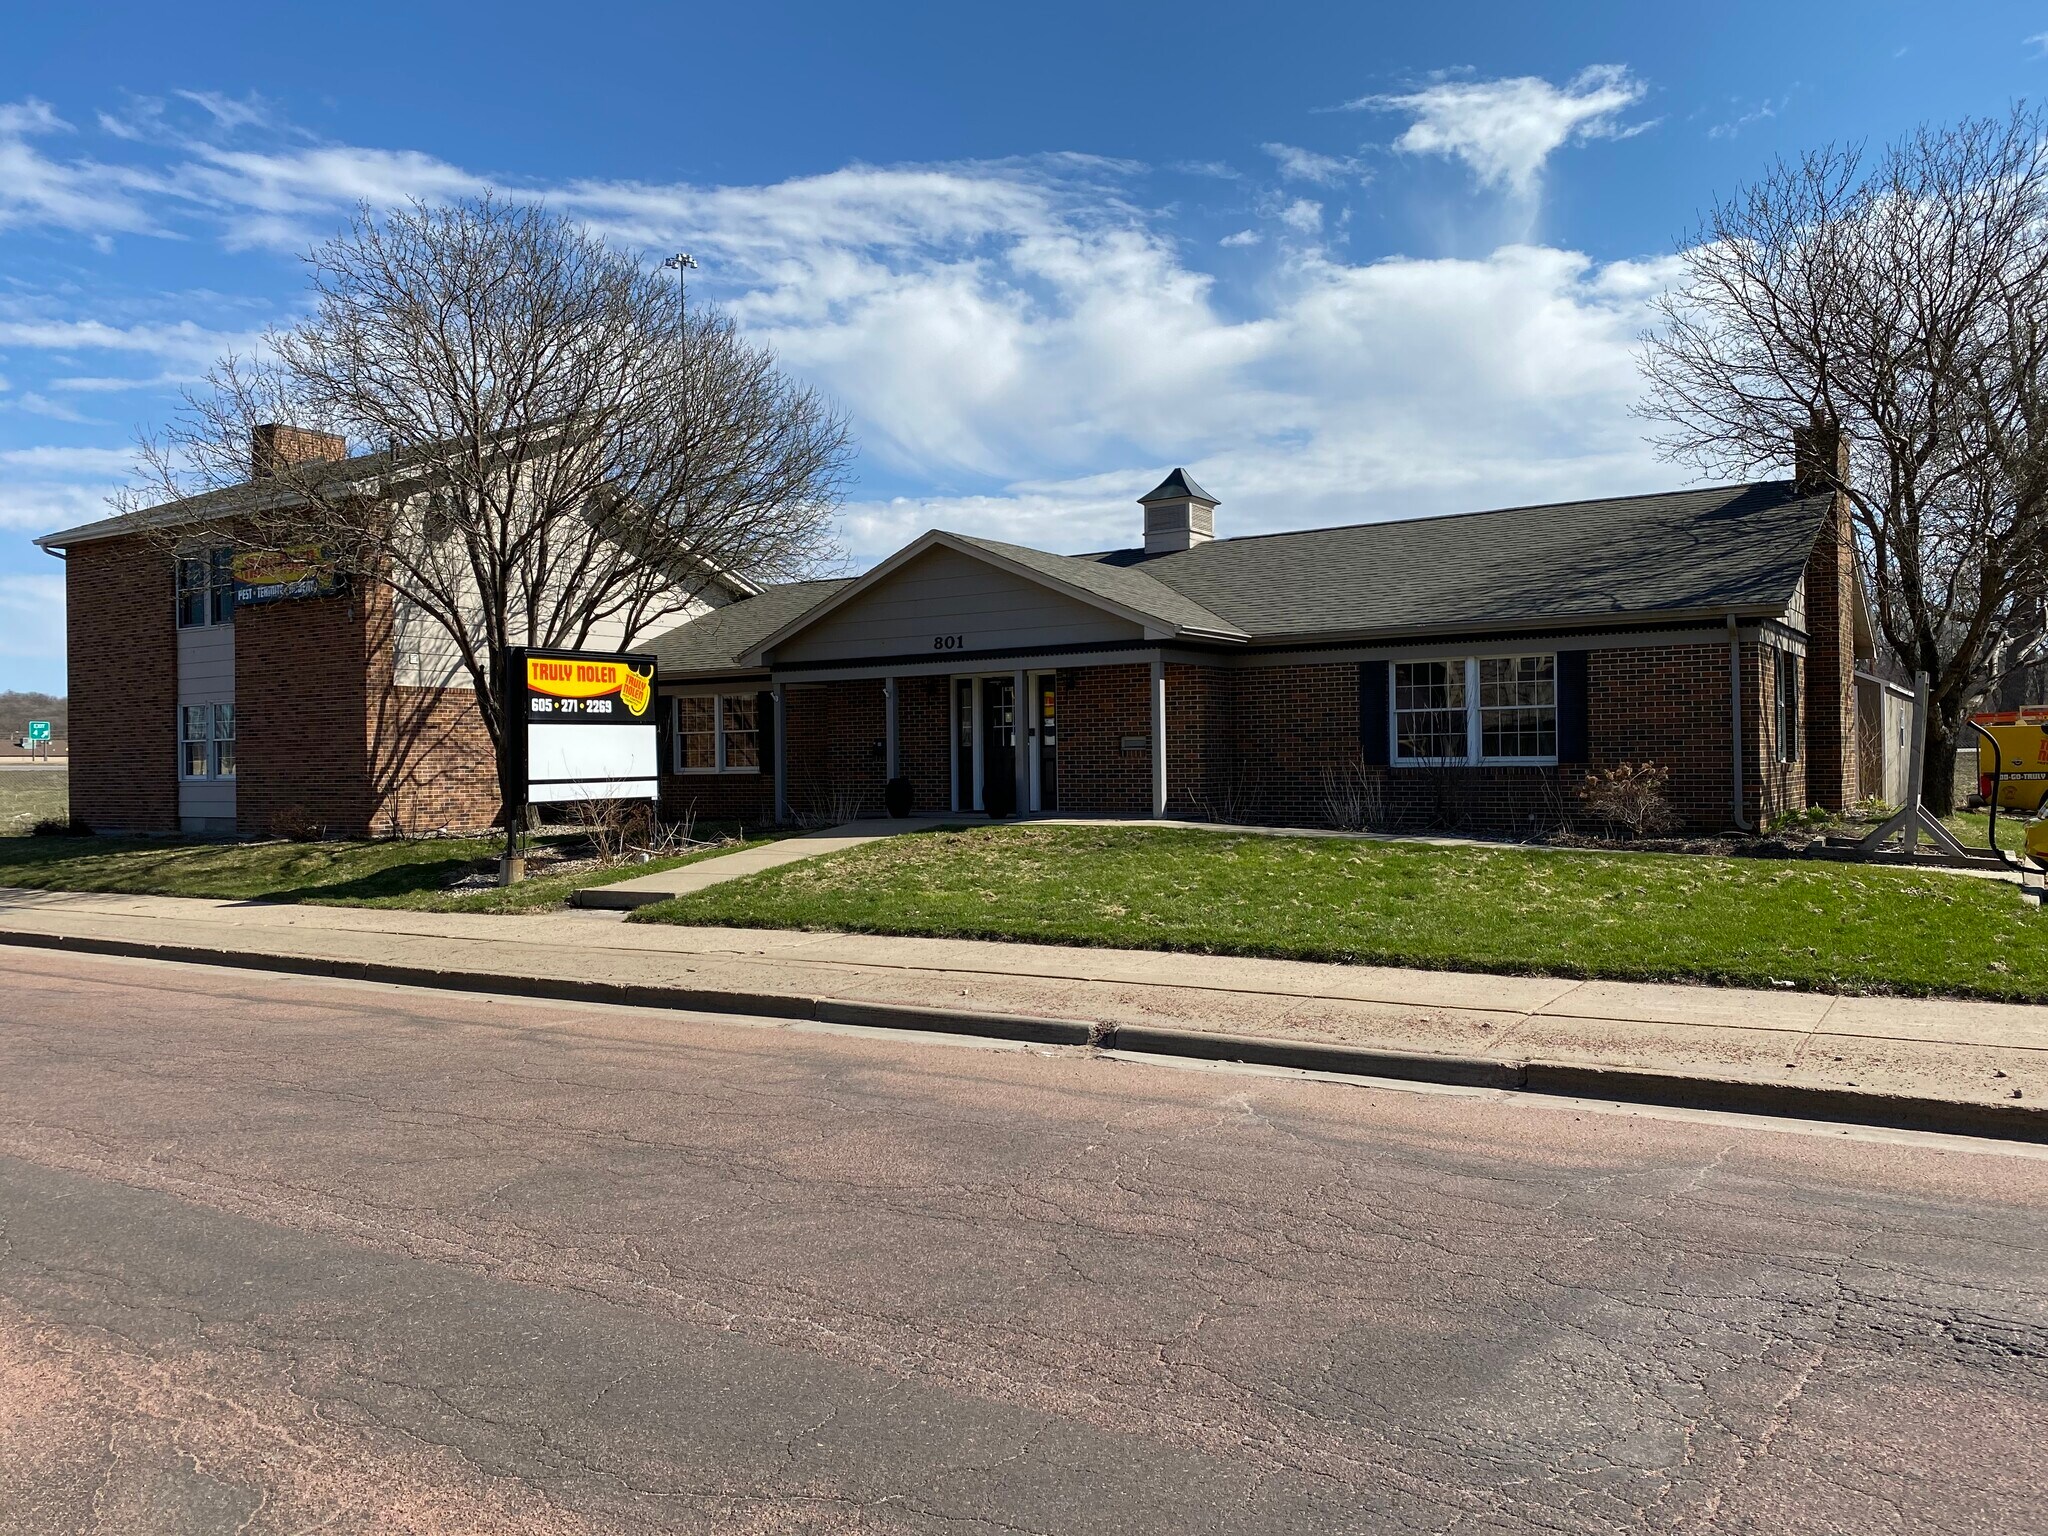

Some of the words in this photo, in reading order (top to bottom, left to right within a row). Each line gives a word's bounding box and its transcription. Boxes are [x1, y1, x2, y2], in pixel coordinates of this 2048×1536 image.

[237, 588, 253, 600] PEST
[934, 635, 963, 650] 801
[532, 663, 572, 681] TRULY
[577, 665, 617, 683] NOLEN
[625, 673, 647, 690] TRULY
